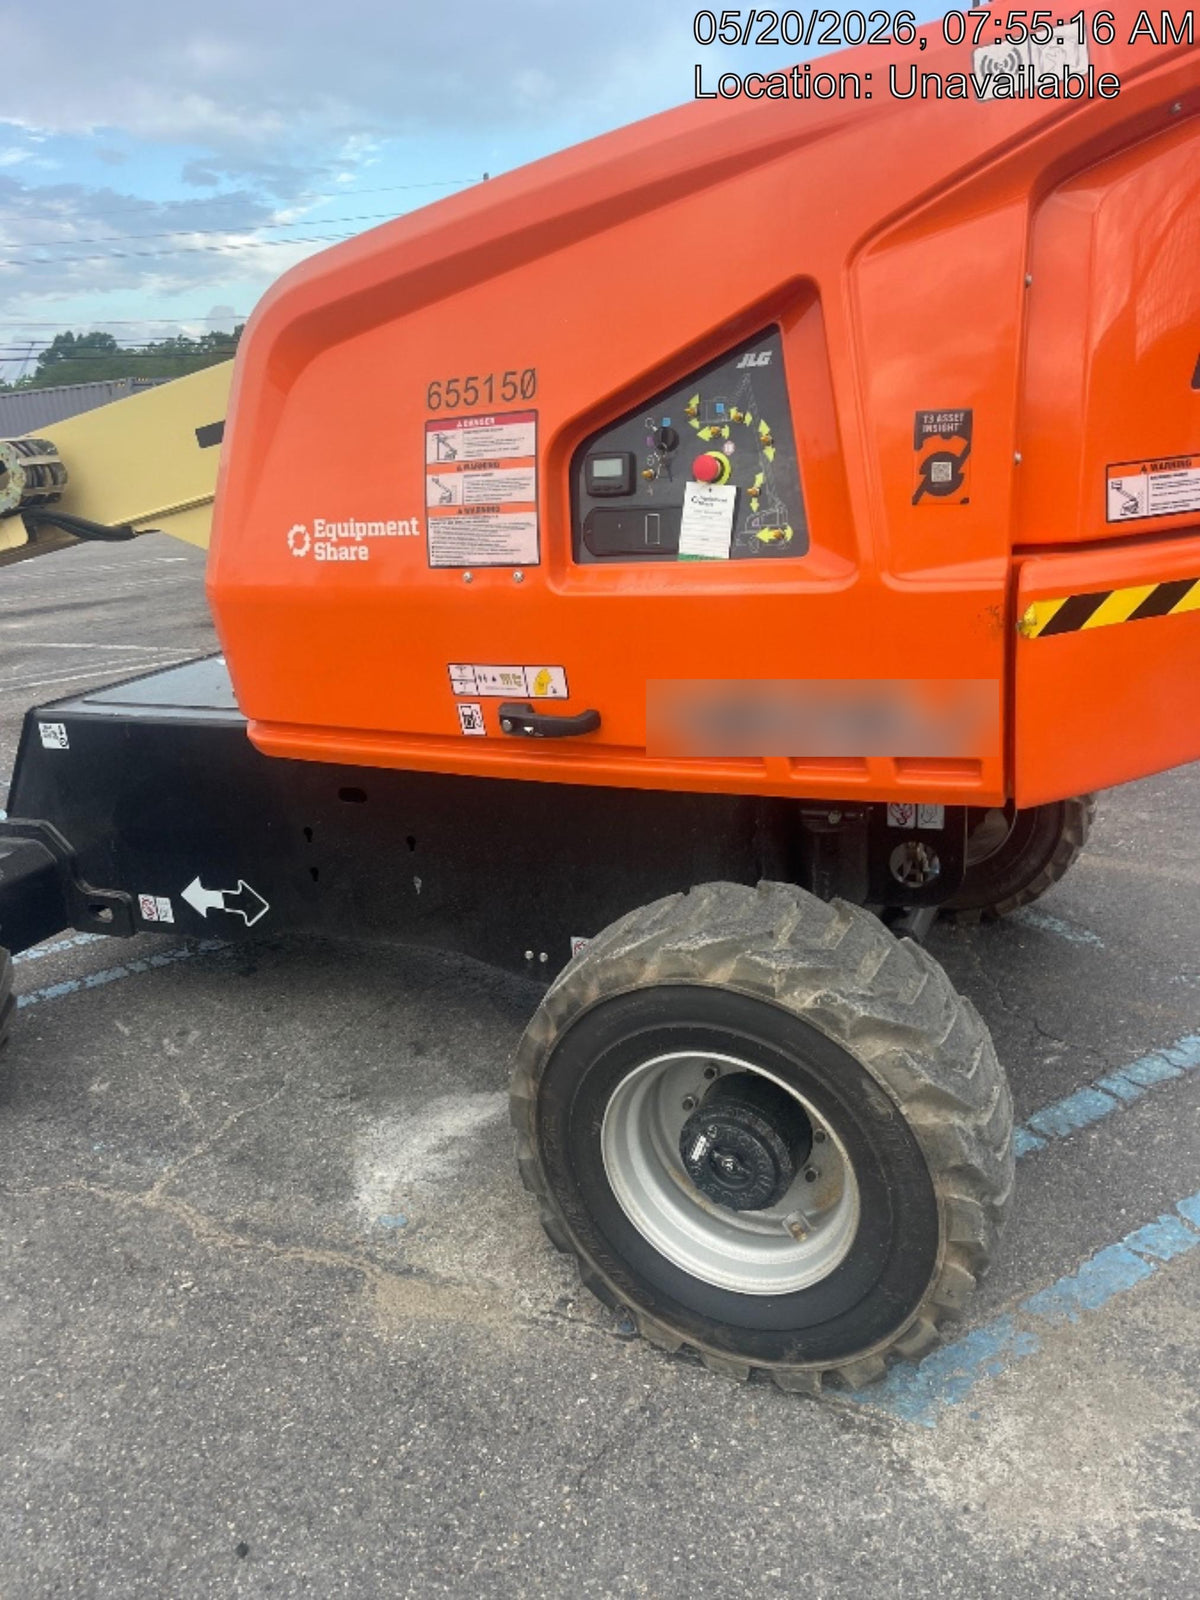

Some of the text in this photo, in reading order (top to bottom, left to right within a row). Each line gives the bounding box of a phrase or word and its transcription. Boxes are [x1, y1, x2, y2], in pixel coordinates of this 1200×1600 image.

[735, 350, 773, 369] JLG
[936, 411, 965, 423] ASSET
[313, 516, 421, 541] Equipment
[313, 541, 370, 562] Share
